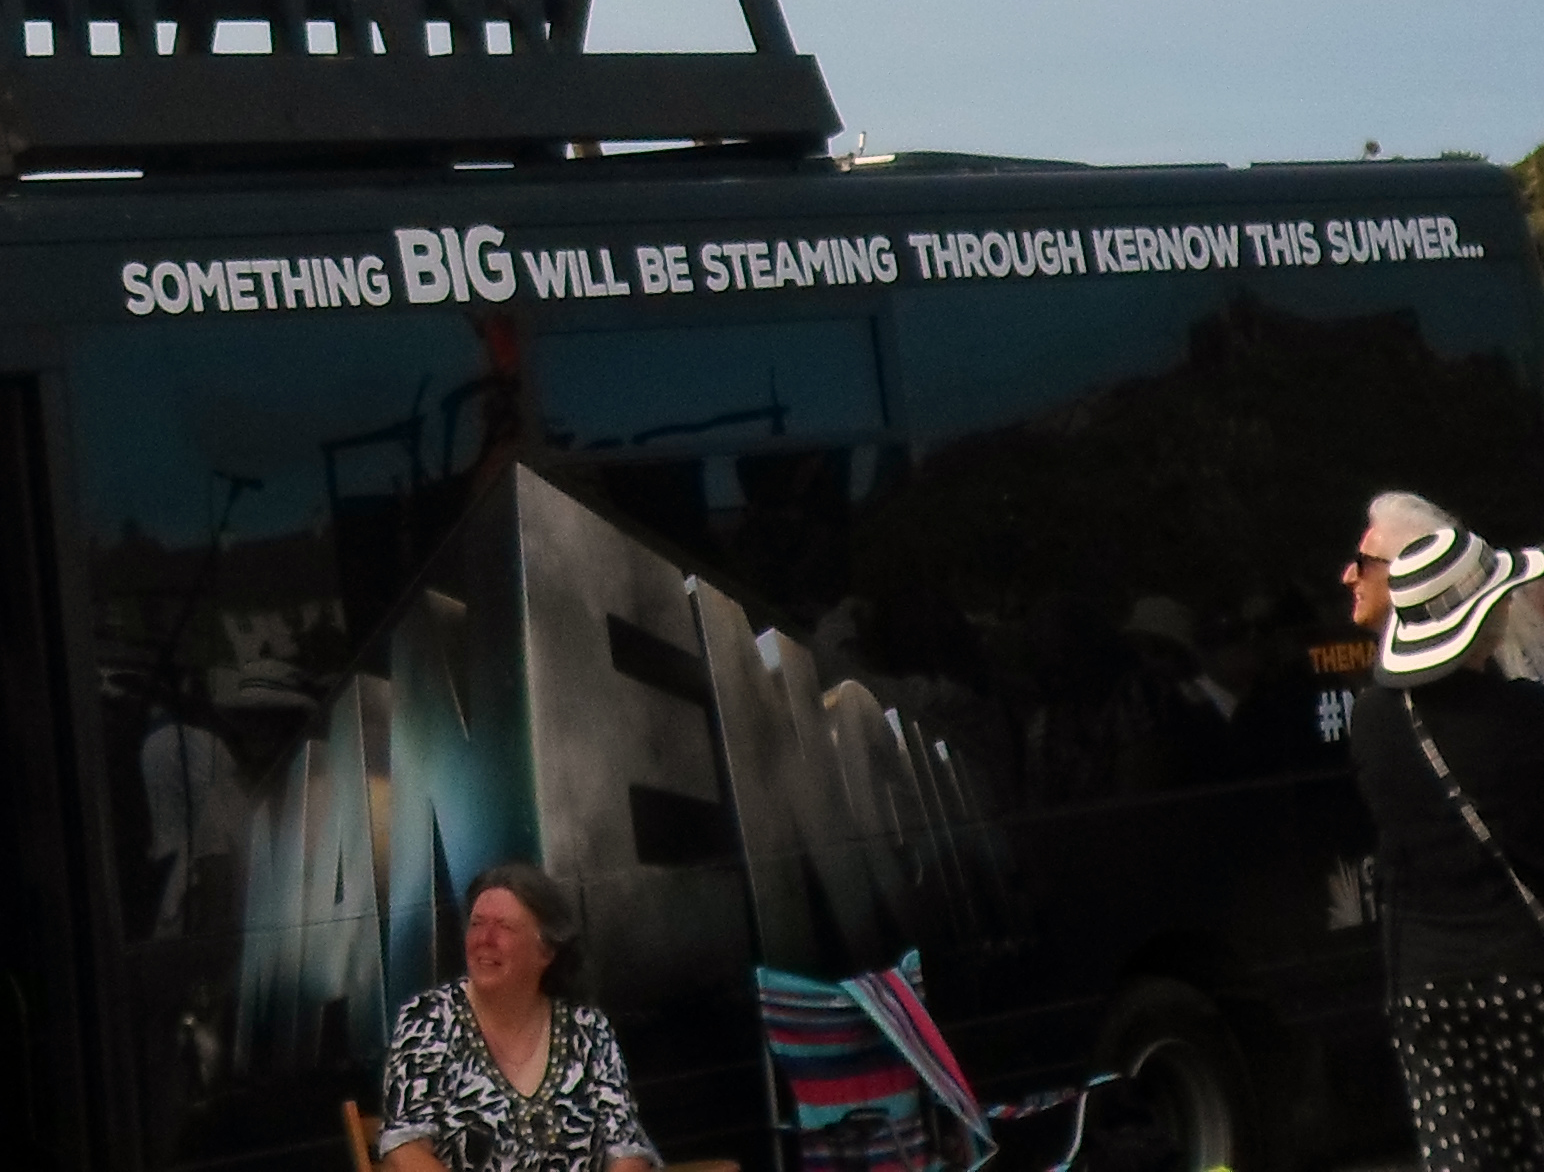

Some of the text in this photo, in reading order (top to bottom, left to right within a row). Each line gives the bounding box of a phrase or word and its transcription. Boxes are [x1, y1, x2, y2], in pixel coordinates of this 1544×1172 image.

[121, 216, 1484, 315] SOMETHING BIG WILL BE STEAMING THROUGH KERNOW THIS SUMMER...
